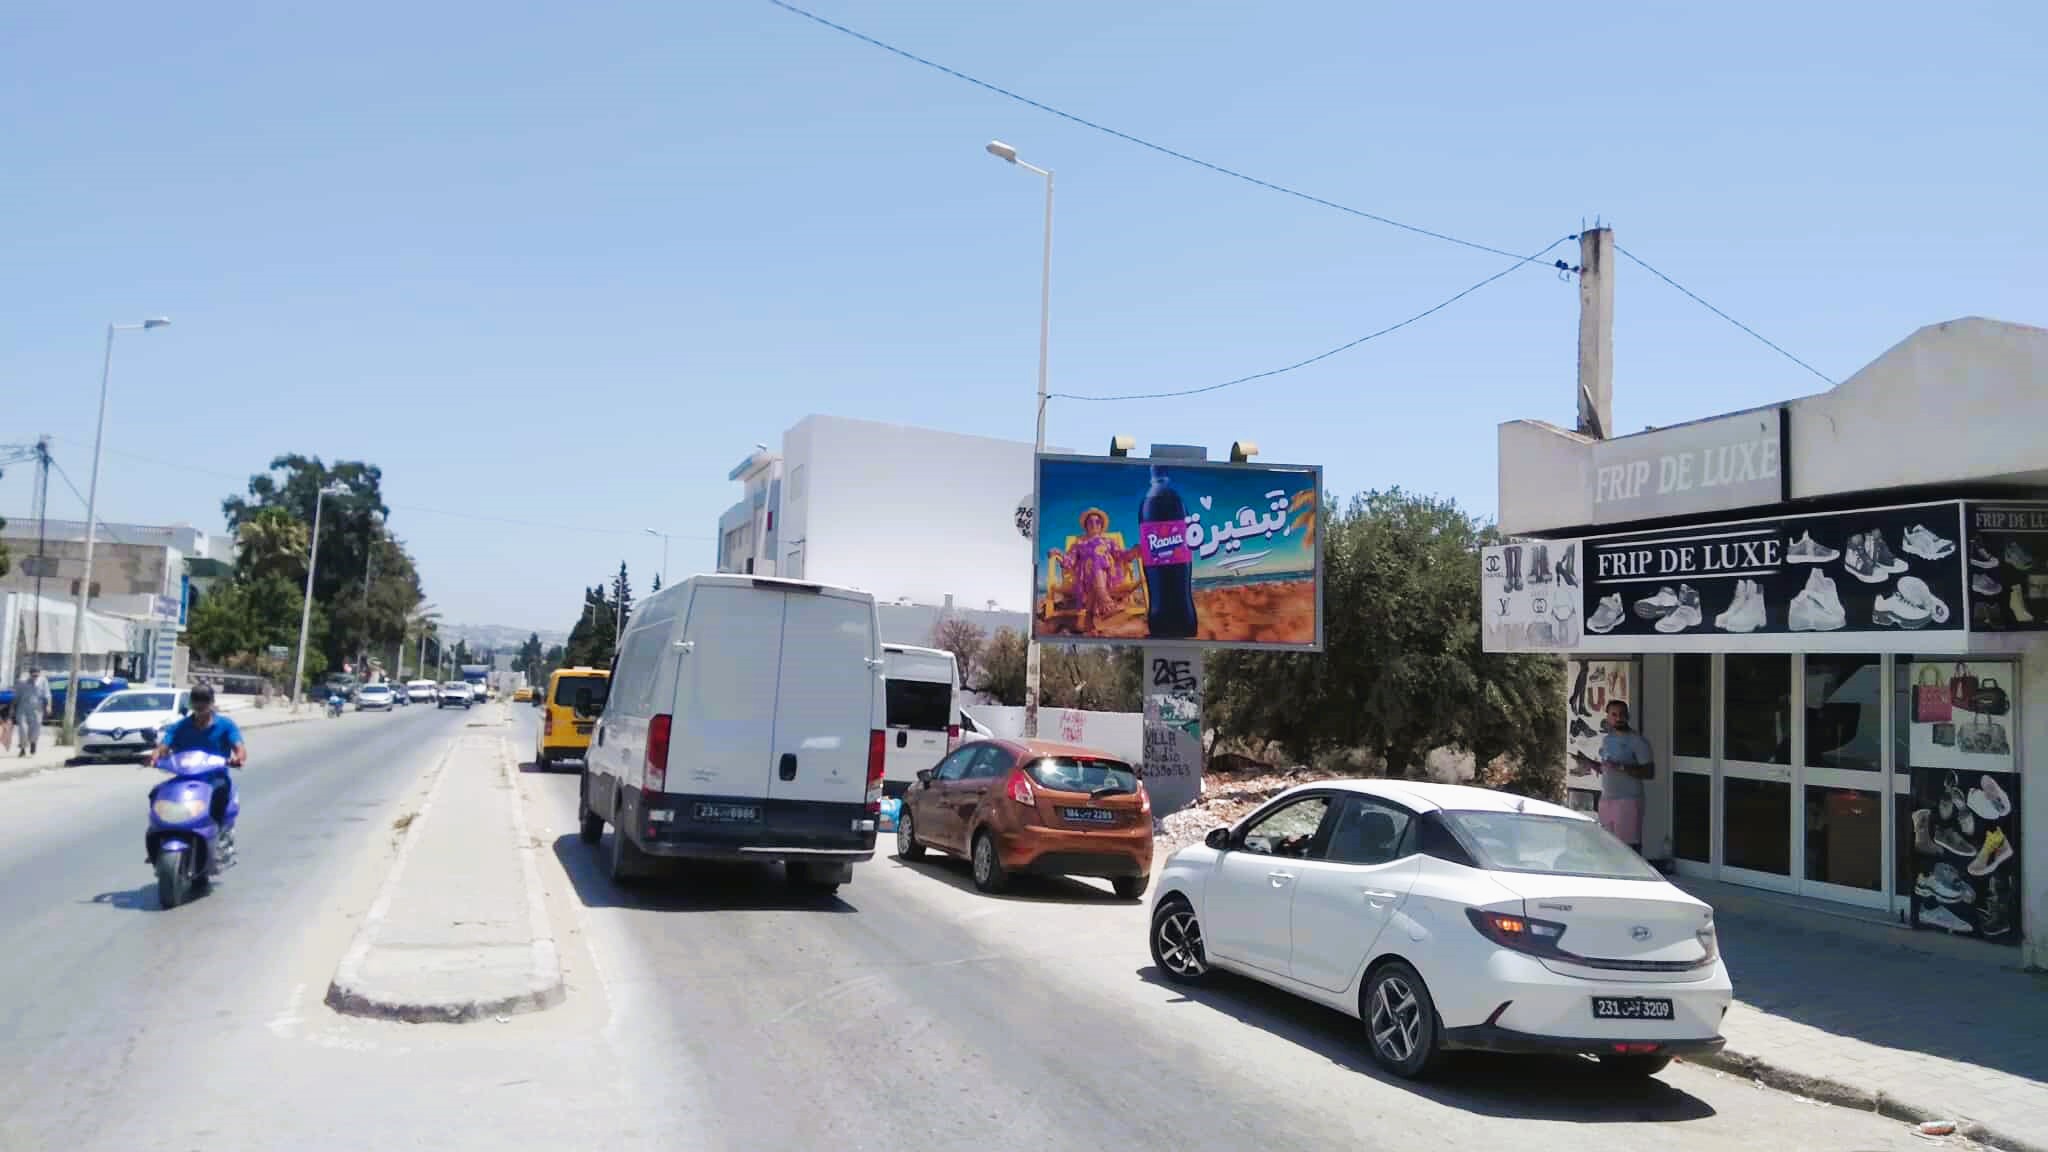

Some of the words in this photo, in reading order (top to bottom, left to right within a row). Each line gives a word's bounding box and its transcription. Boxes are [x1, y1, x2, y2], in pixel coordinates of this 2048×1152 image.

[1595, 460, 1650, 503] FRIP
[1657, 452, 1696, 494] DE
[1700, 438, 1778, 488] LUXE
[1976, 511, 2006, 528] FRIP
[2008, 512, 2028, 528] DE
[1598, 550, 1652, 577] FRIP
[1660, 547, 1696, 573] DE
[1703, 539, 1782, 570] LUXE
[1598, 1000, 1620, 1016] 231
[1642, 1001, 1669, 1017] 3209
